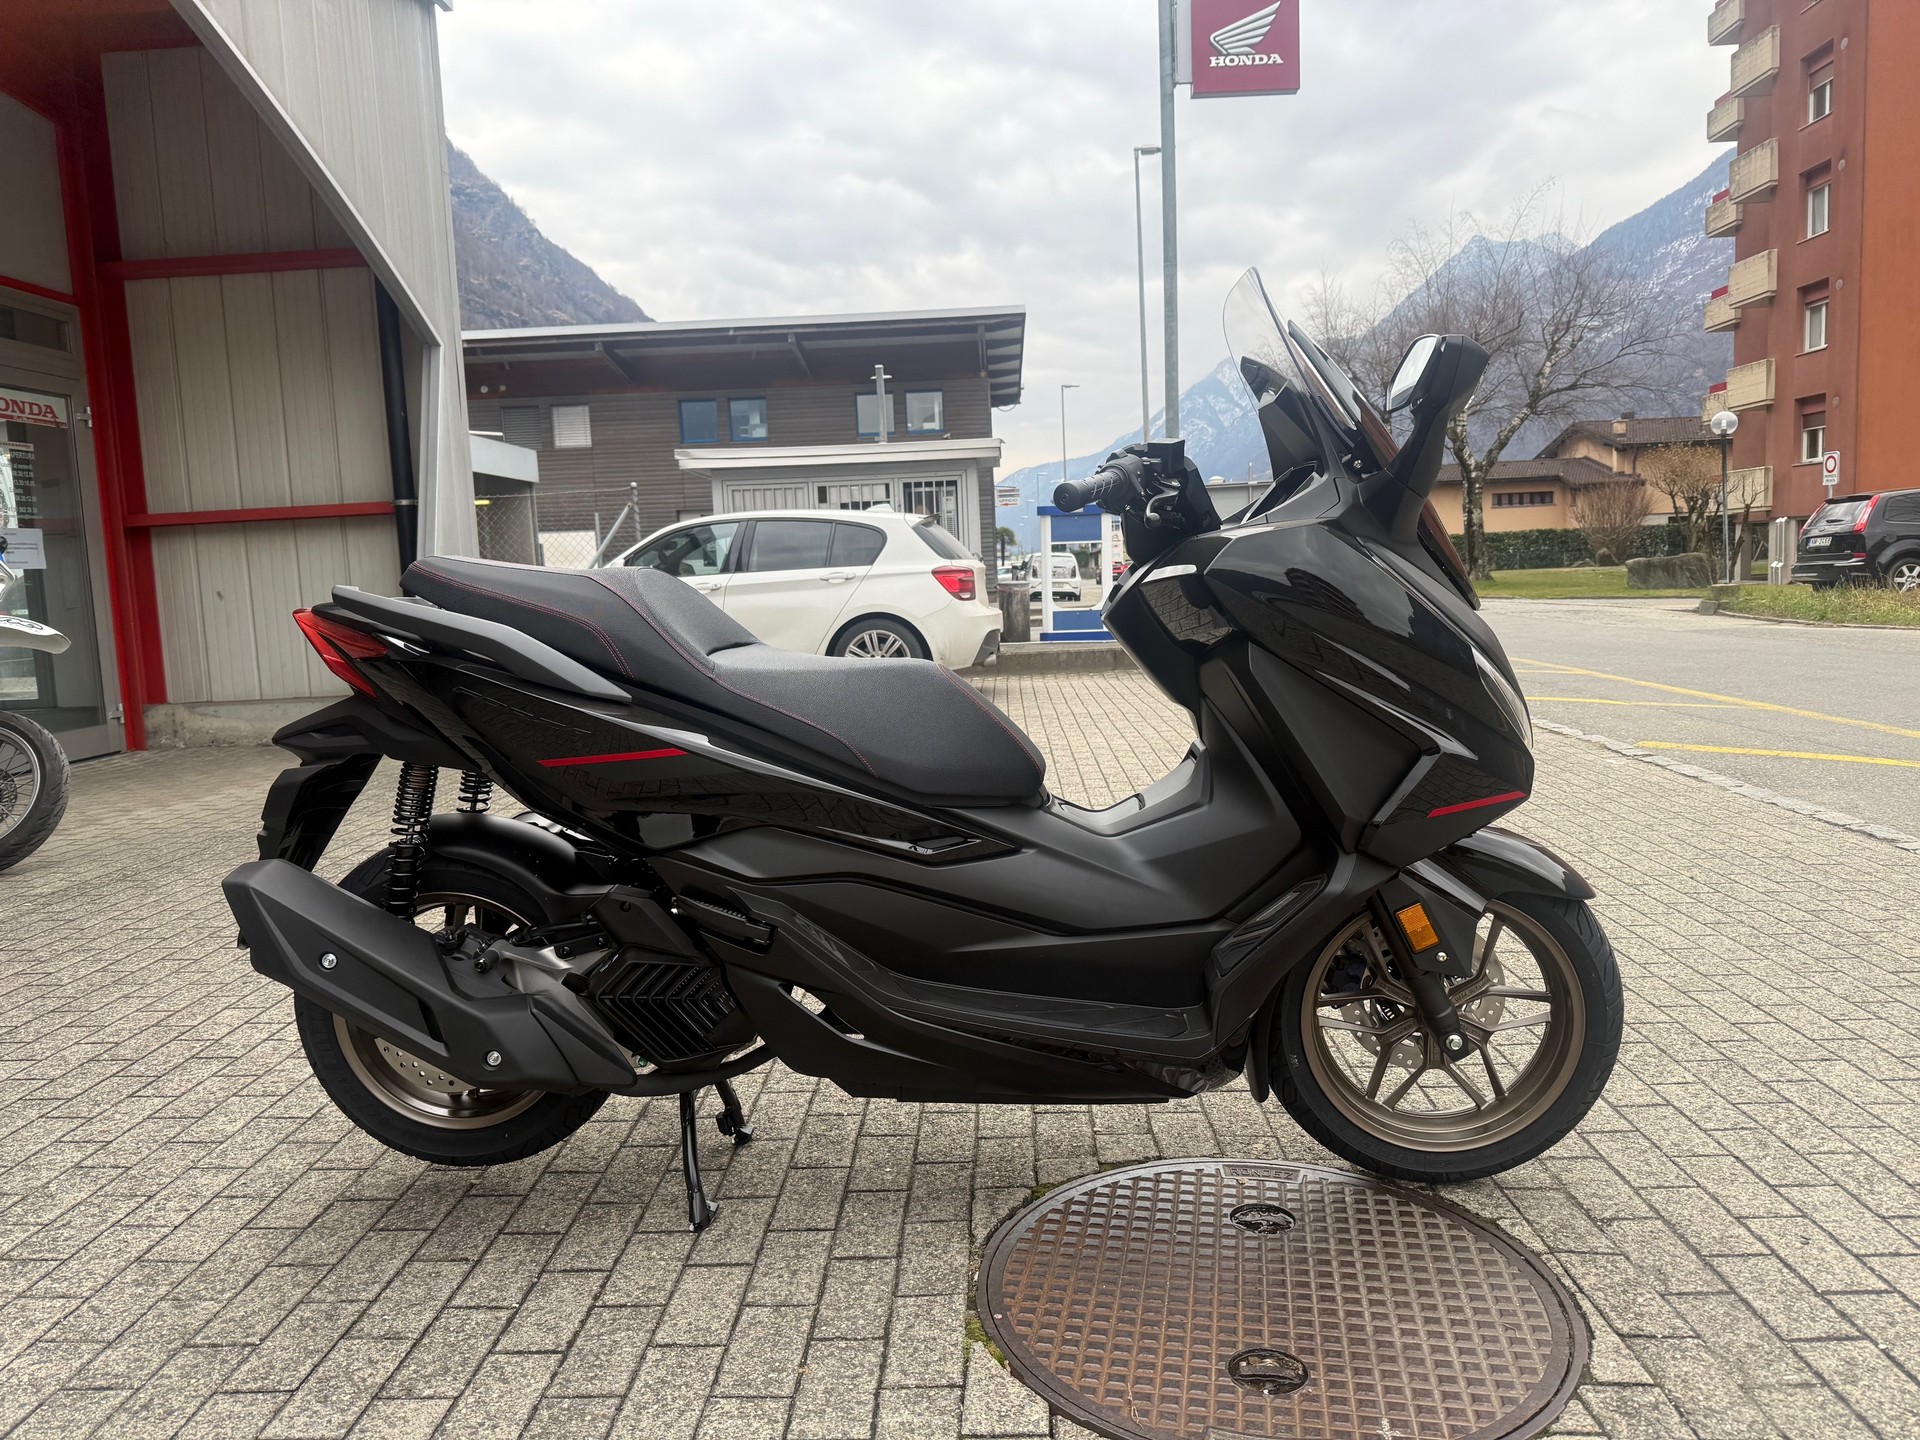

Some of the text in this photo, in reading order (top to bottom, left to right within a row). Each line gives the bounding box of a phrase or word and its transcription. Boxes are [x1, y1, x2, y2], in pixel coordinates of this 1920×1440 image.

[1209, 54, 1284, 67] HONDA
[0, 396, 59, 419] ONDA
[1230, 1167, 1294, 1179] RONDEZ
